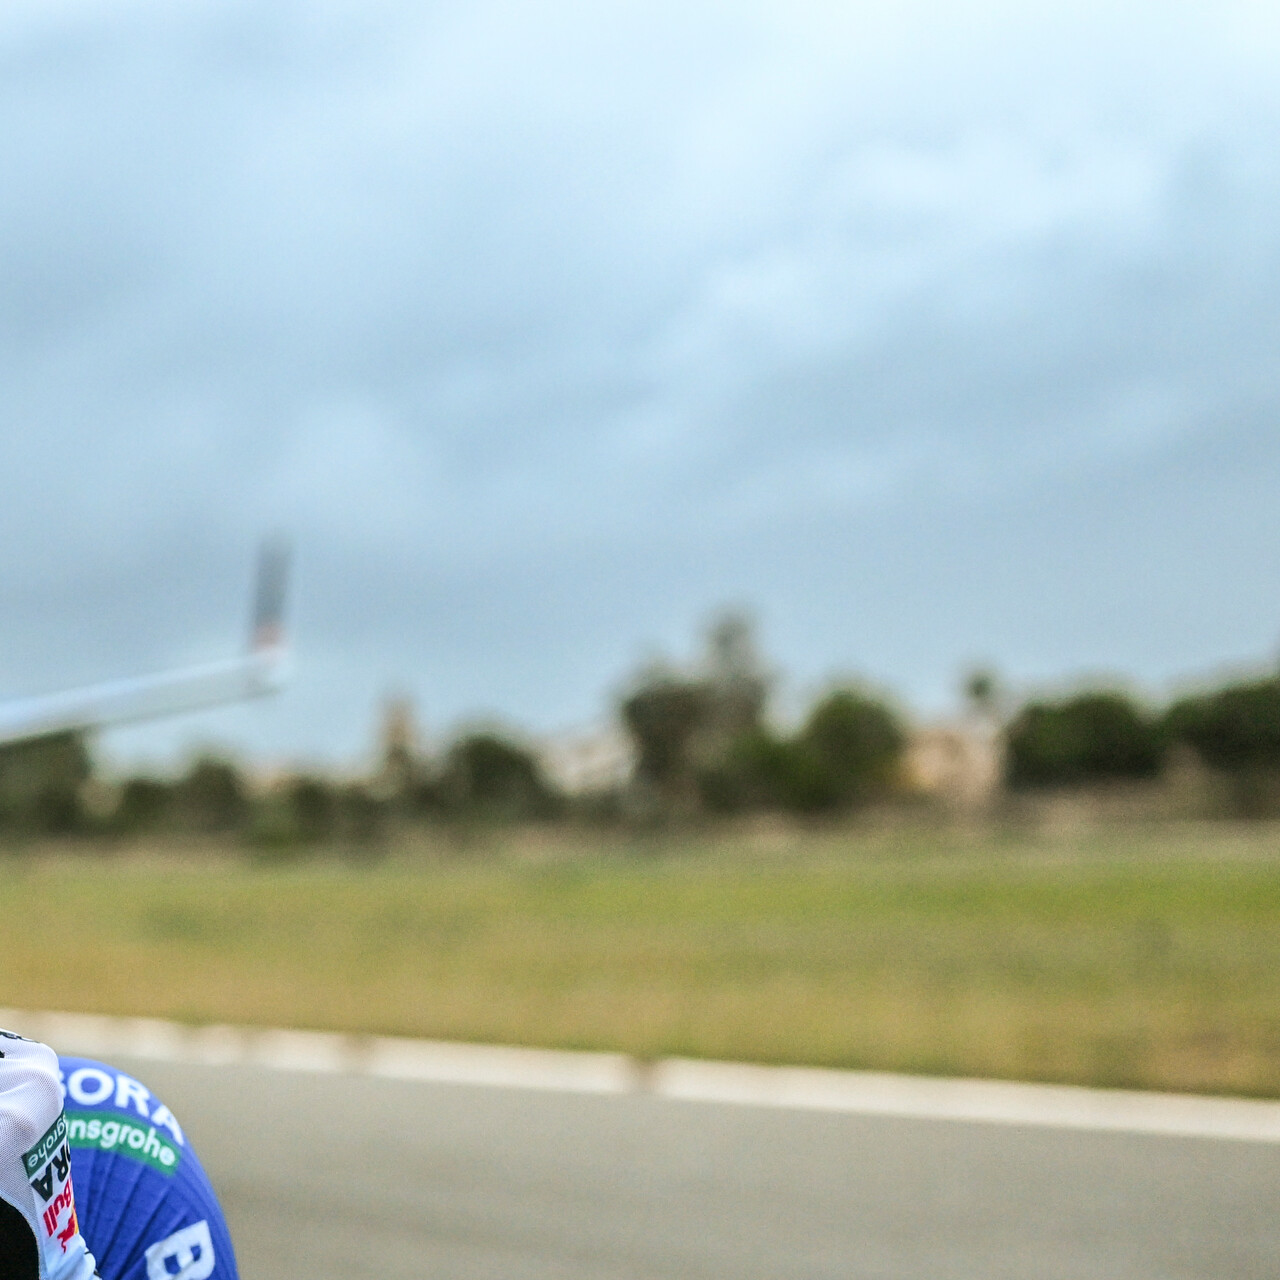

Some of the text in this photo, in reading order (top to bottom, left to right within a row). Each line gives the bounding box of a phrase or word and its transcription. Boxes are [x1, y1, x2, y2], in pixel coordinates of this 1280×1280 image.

[59, 1067, 185, 1147] ORA
[27, 1112, 68, 1169] grohe
[64, 1117, 176, 1167] nsgrohe
[30, 1144, 71, 1202] RA
